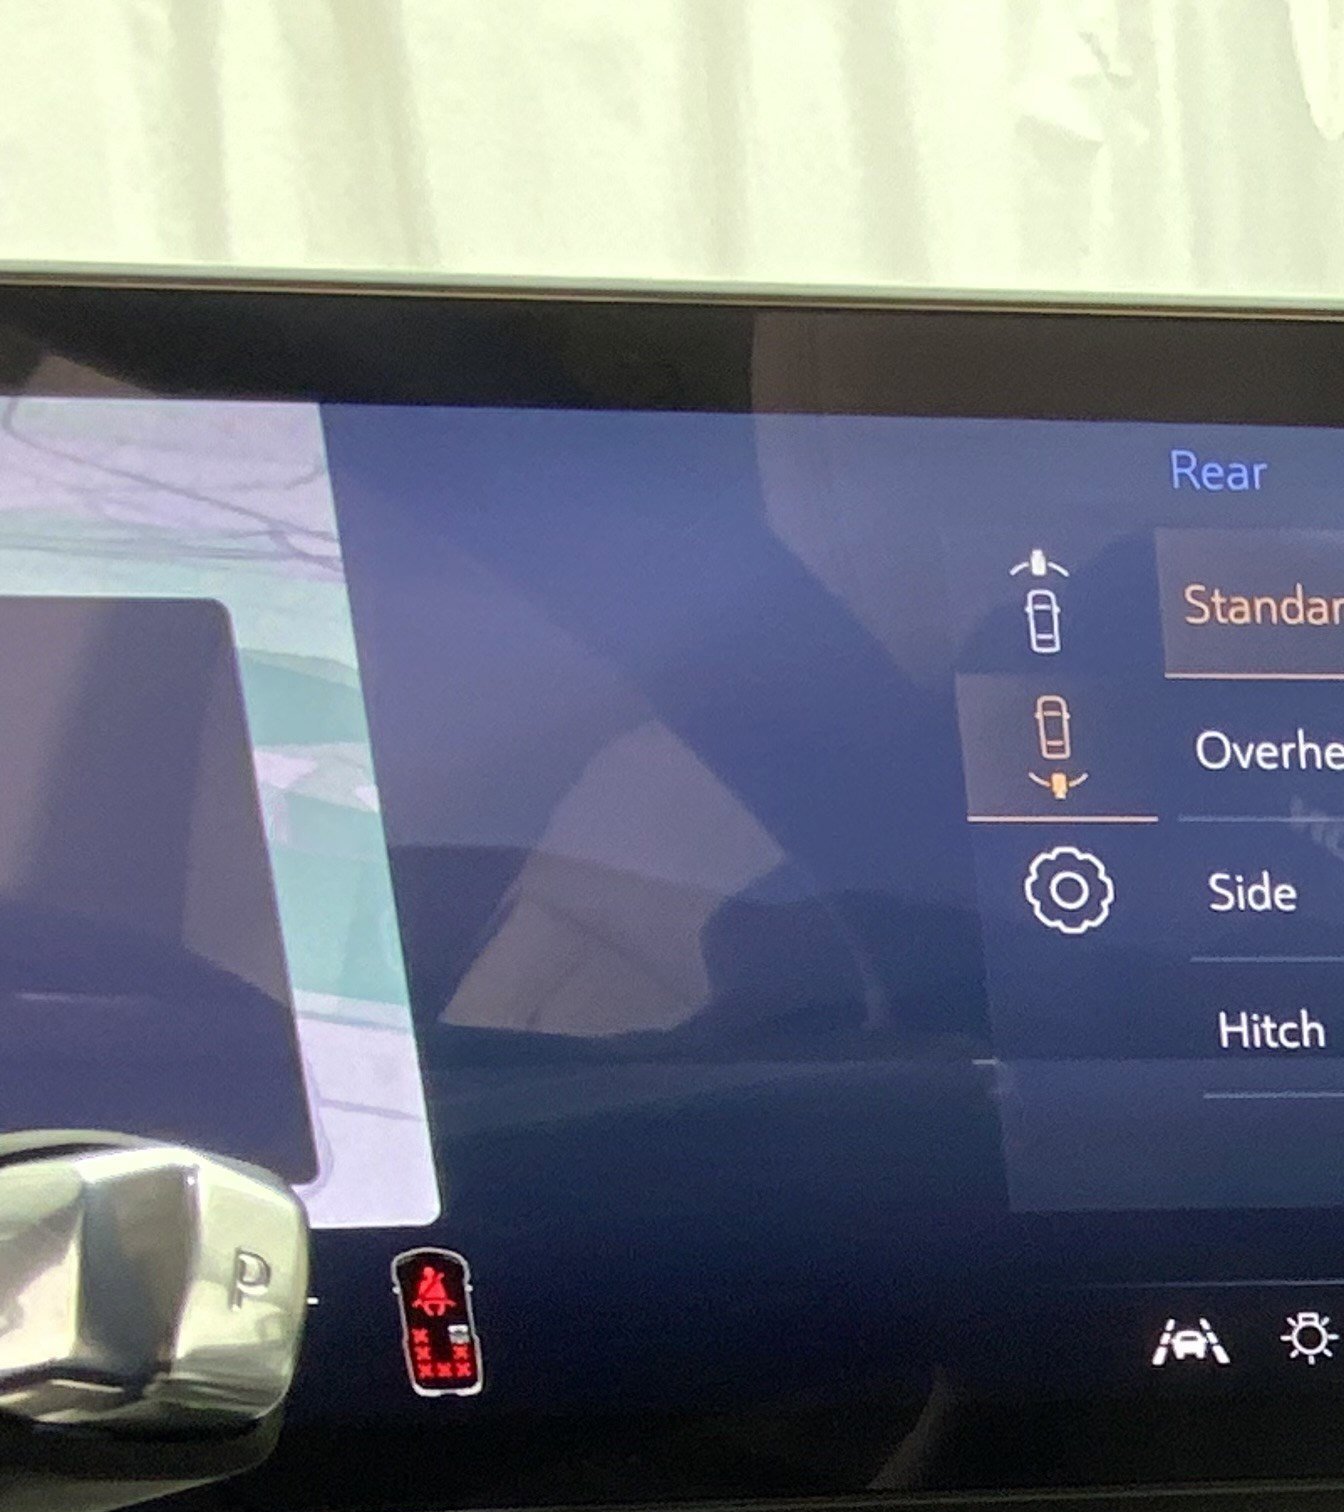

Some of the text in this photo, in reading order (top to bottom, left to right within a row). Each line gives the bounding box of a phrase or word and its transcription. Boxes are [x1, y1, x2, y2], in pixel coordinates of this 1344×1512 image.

[1170, 448, 1269, 492] Rear
[1207, 869, 1298, 912] Side
[1218, 1007, 1326, 1050] Hitch
[231, 1247, 272, 1311] P
